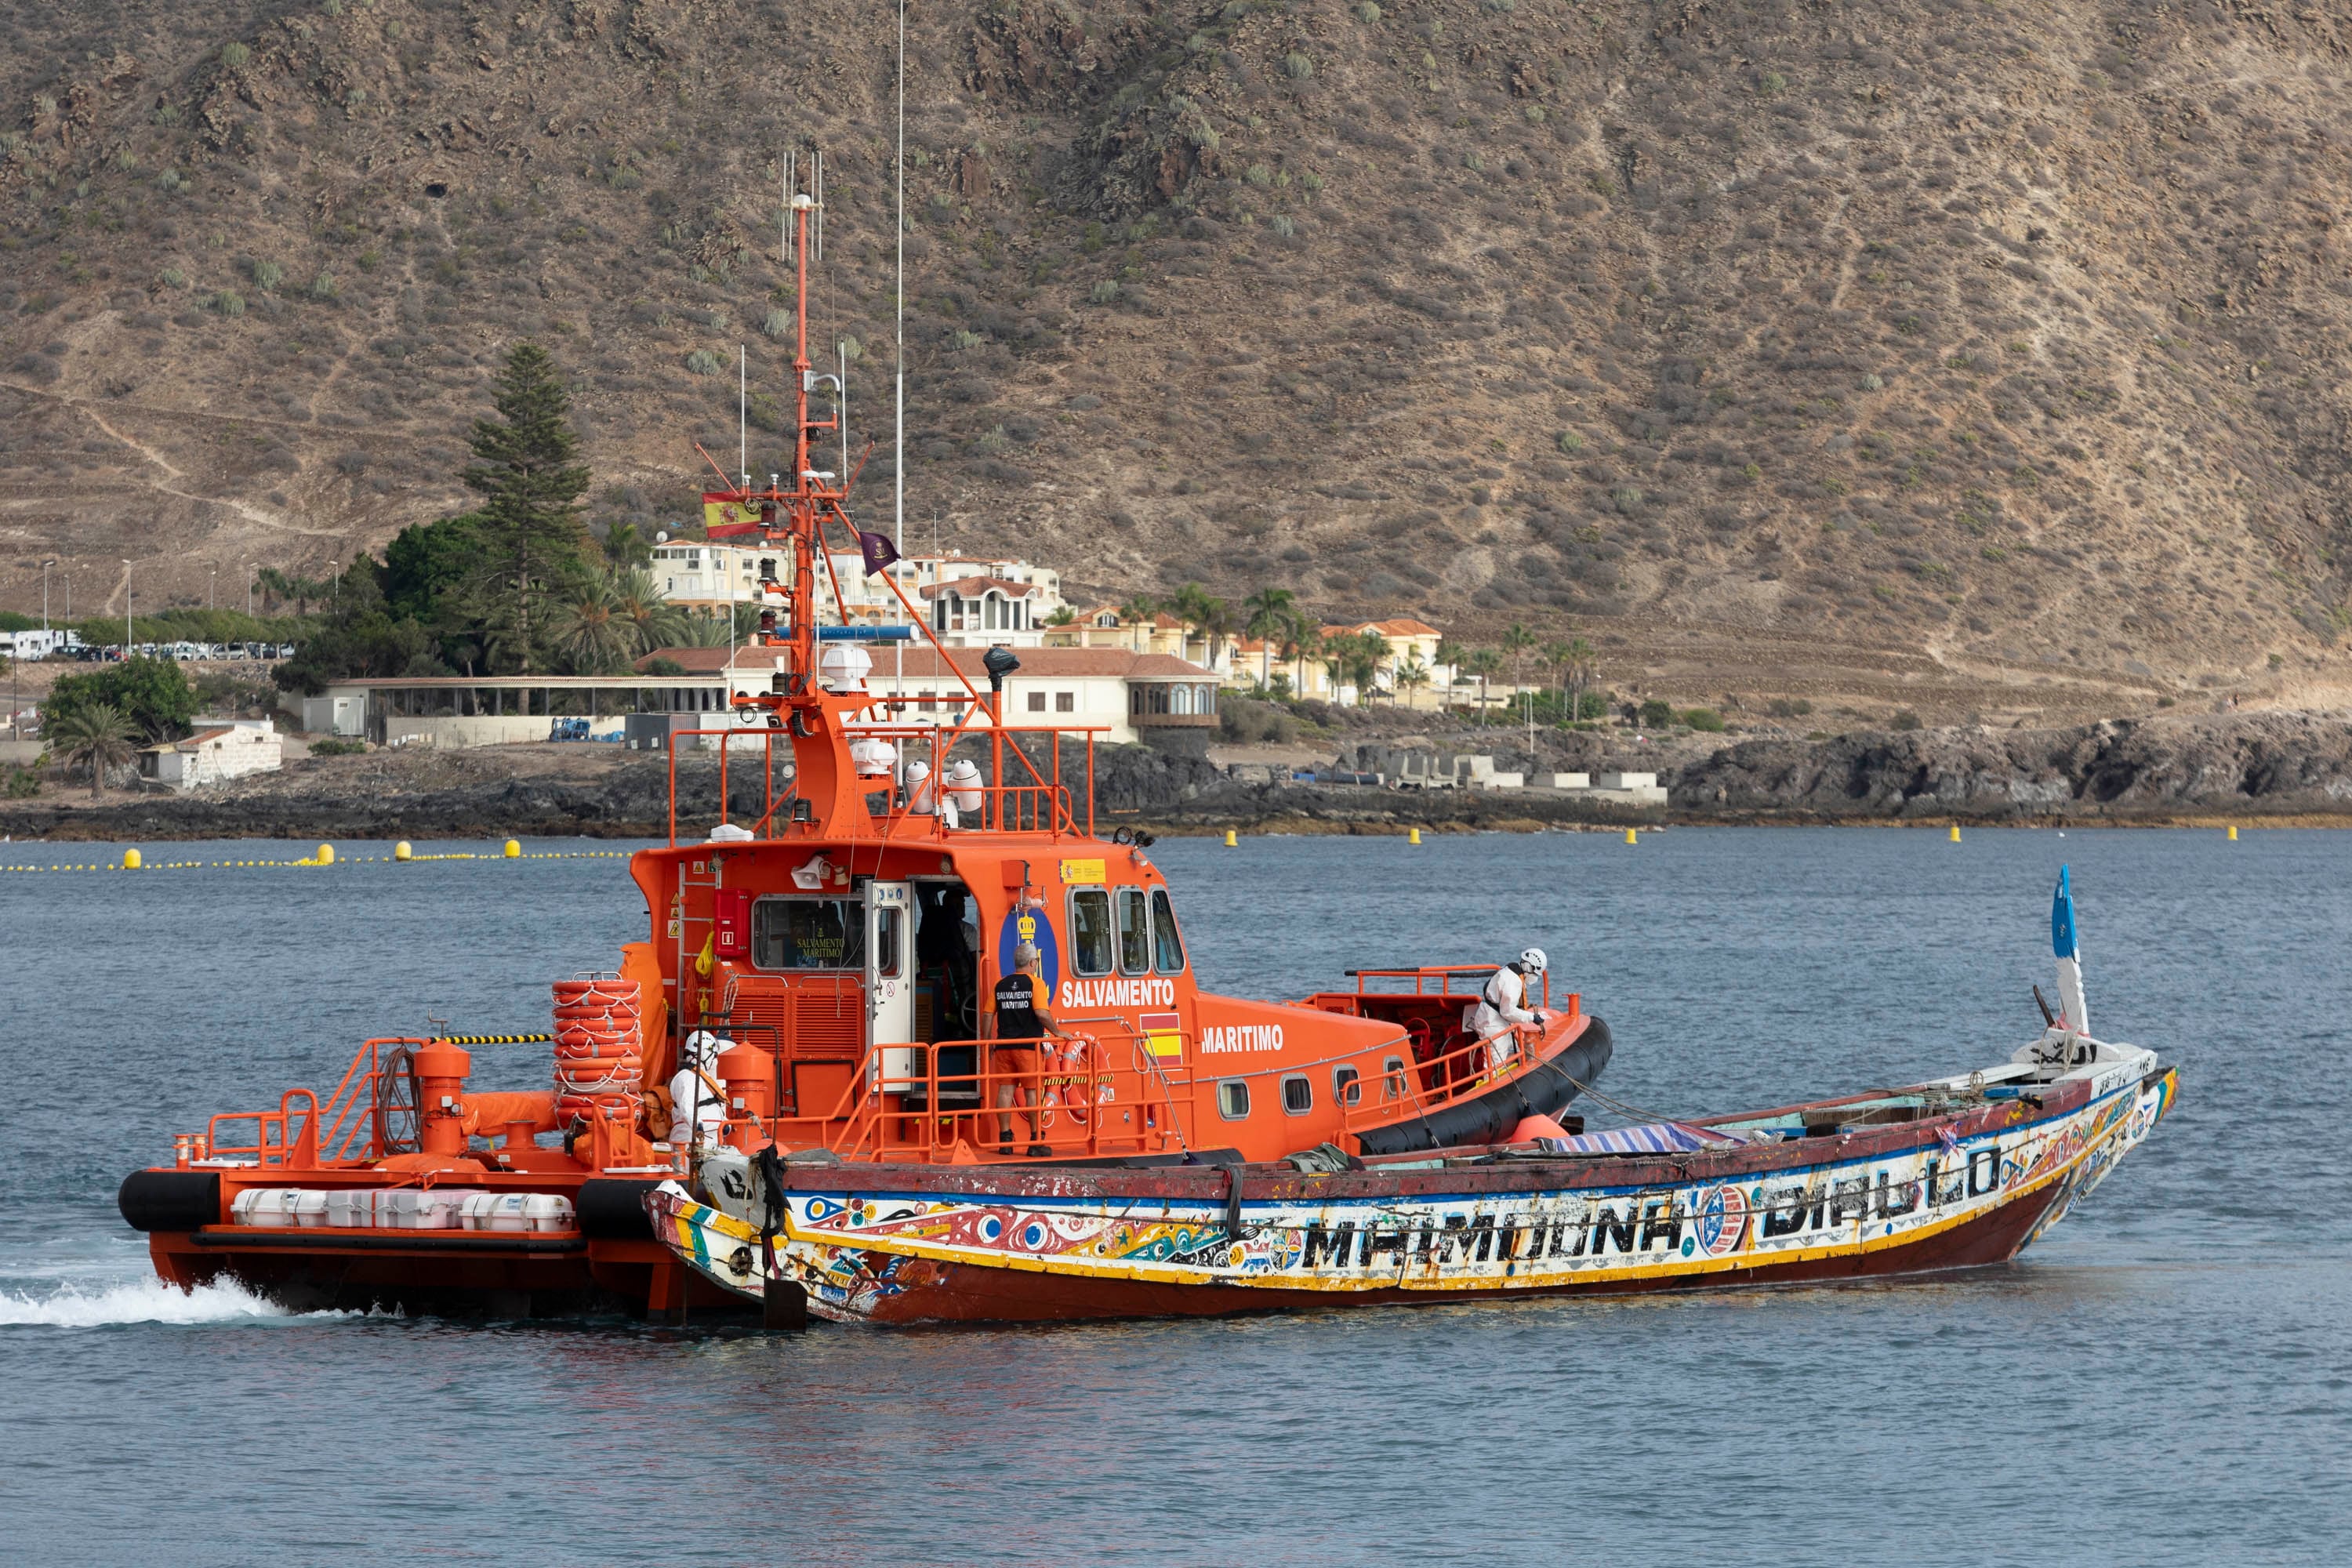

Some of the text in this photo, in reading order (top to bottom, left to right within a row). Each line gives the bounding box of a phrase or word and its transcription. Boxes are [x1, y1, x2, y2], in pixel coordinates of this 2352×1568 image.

[797, 938, 845, 948] SALVAMENTO
[803, 948, 840, 958] MARITIMO
[996, 991, 1033, 1000] SALVAMENTO
[1062, 979, 1174, 1008] SALVAMENTO
[1001, 1000, 1029, 1010] MARITIMO
[1201, 1024, 1283, 1054] MARITIMO
